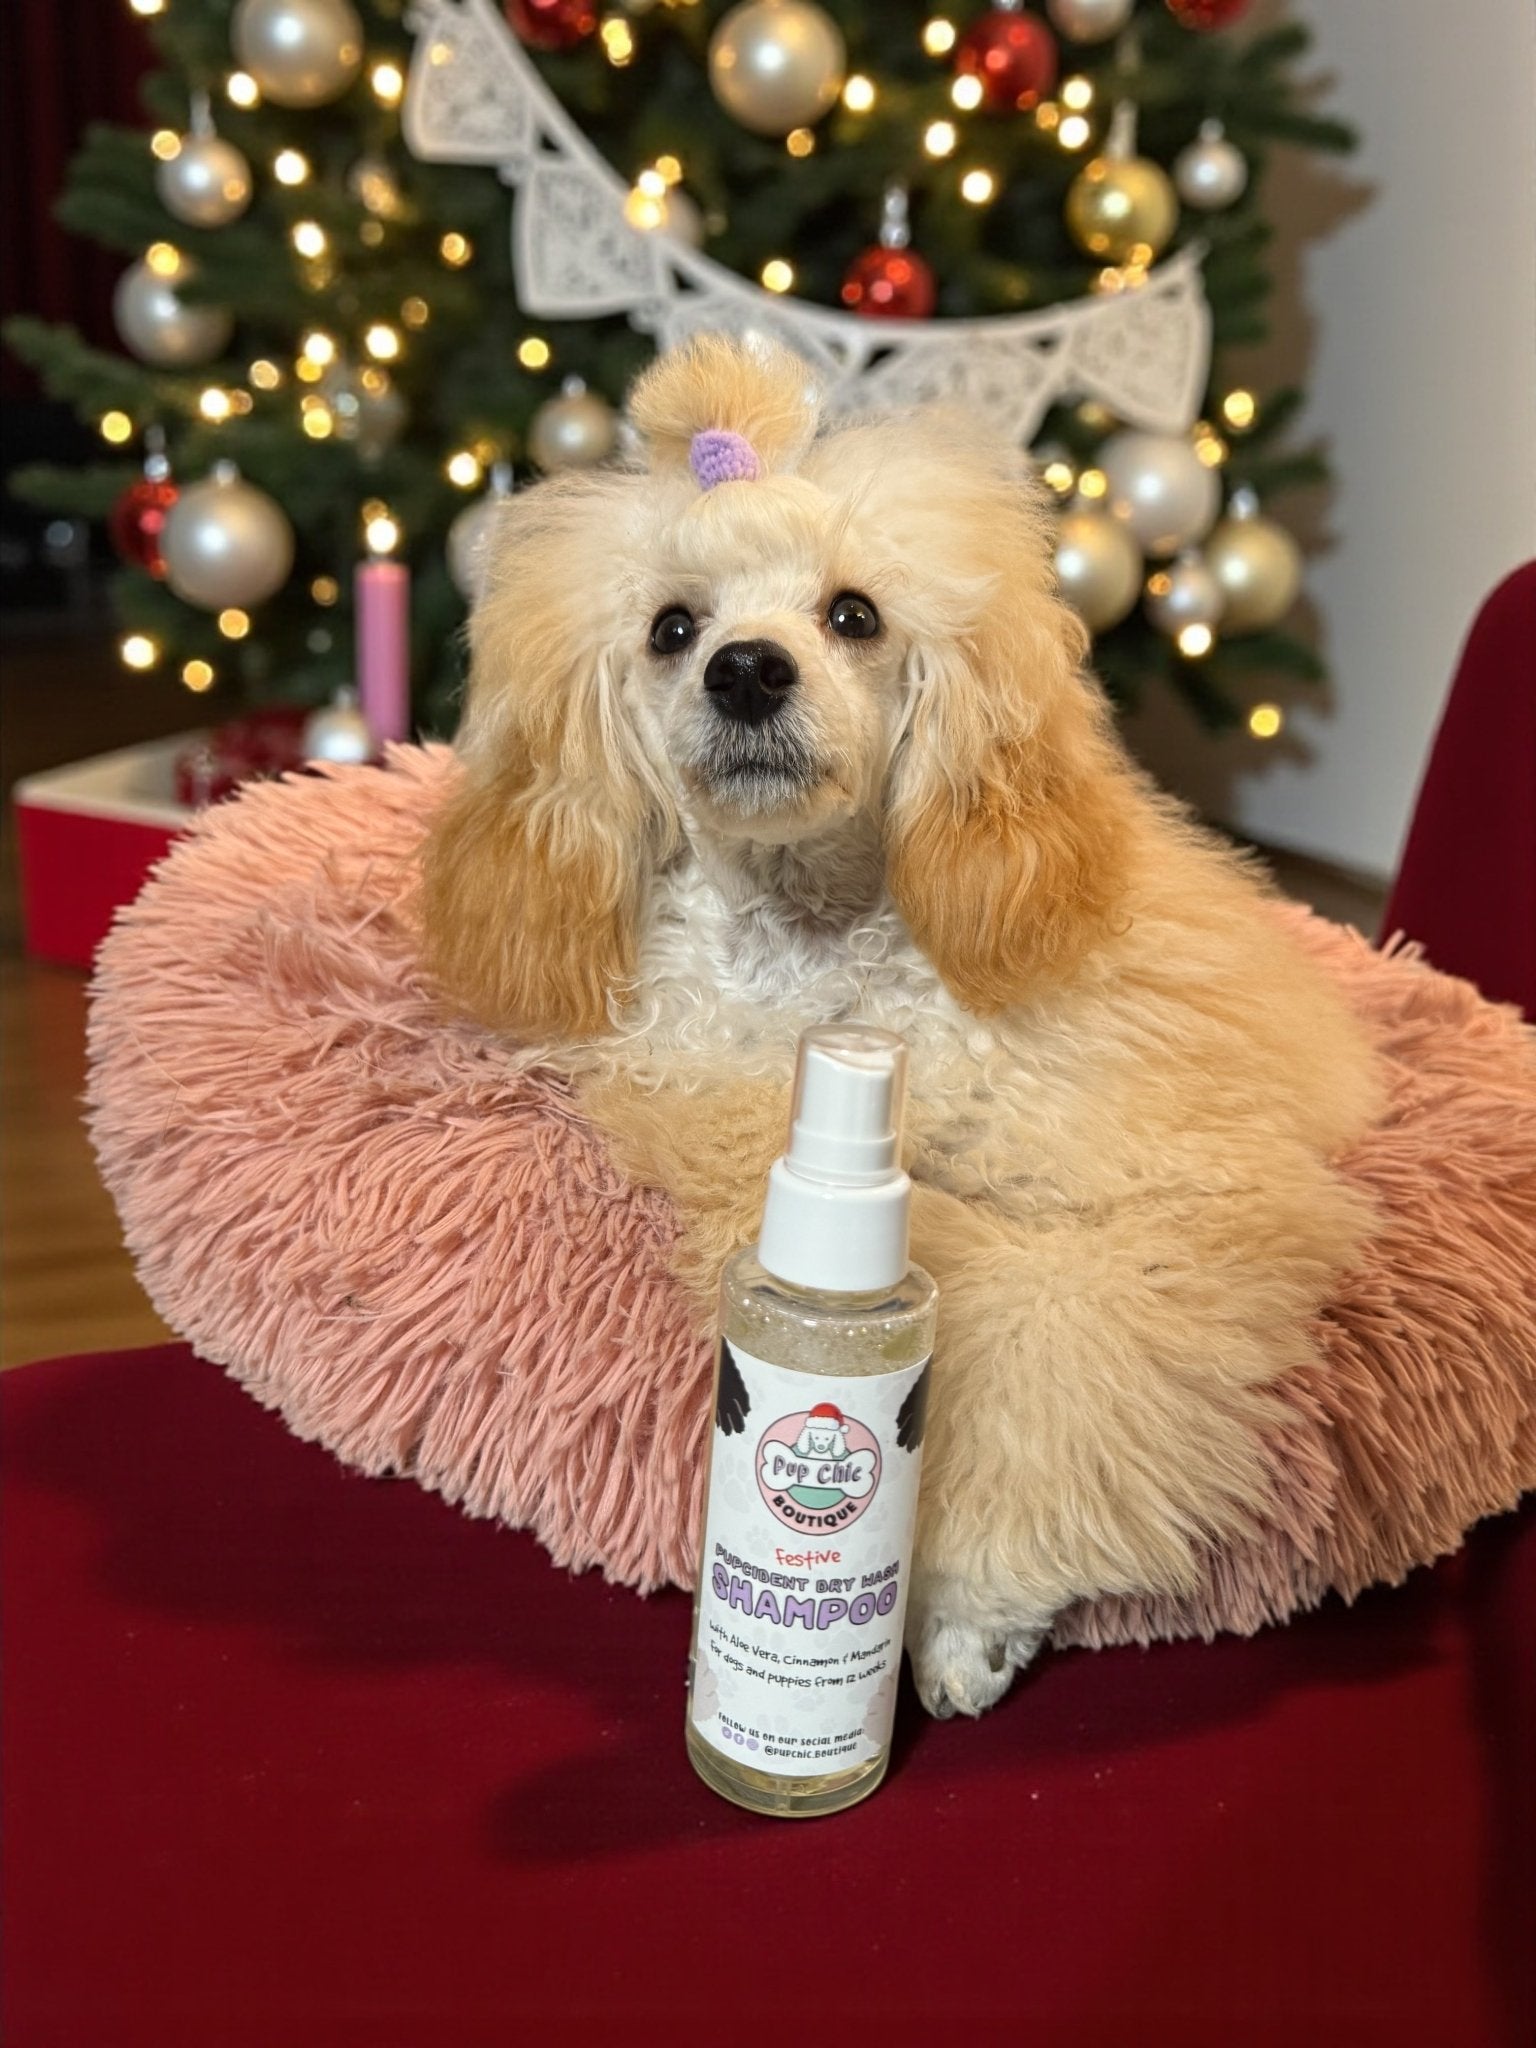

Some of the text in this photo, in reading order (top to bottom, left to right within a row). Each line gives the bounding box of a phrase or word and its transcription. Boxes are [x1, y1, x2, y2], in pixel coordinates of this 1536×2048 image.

[773, 1455, 862, 1484] Pup Chic
[772, 1495, 858, 1527] BOUTIQUE
[715, 1542, 900, 1593] PUPCIDENT DRY WASH
[775, 1548, 841, 1570] Festive
[712, 1562, 898, 1630] SHAMPOO
[709, 1619, 729, 1641] with
[730, 1634, 750, 1652] Aloe
[752, 1646, 780, 1664] Vera,
[783, 1655, 839, 1668] Cinnamon
[850, 1639, 891, 1662] Mandarin
[723, 1654, 744, 1671] dogs
[745, 1666, 766, 1680] and
[767, 1673, 812, 1688] puppies
[815, 1676, 843, 1688] from
[846, 1674, 856, 1684] 12
[858, 1659, 887, 1680] weeks
[748, 1727, 760, 1739] us
[778, 1736, 798, 1746] our
